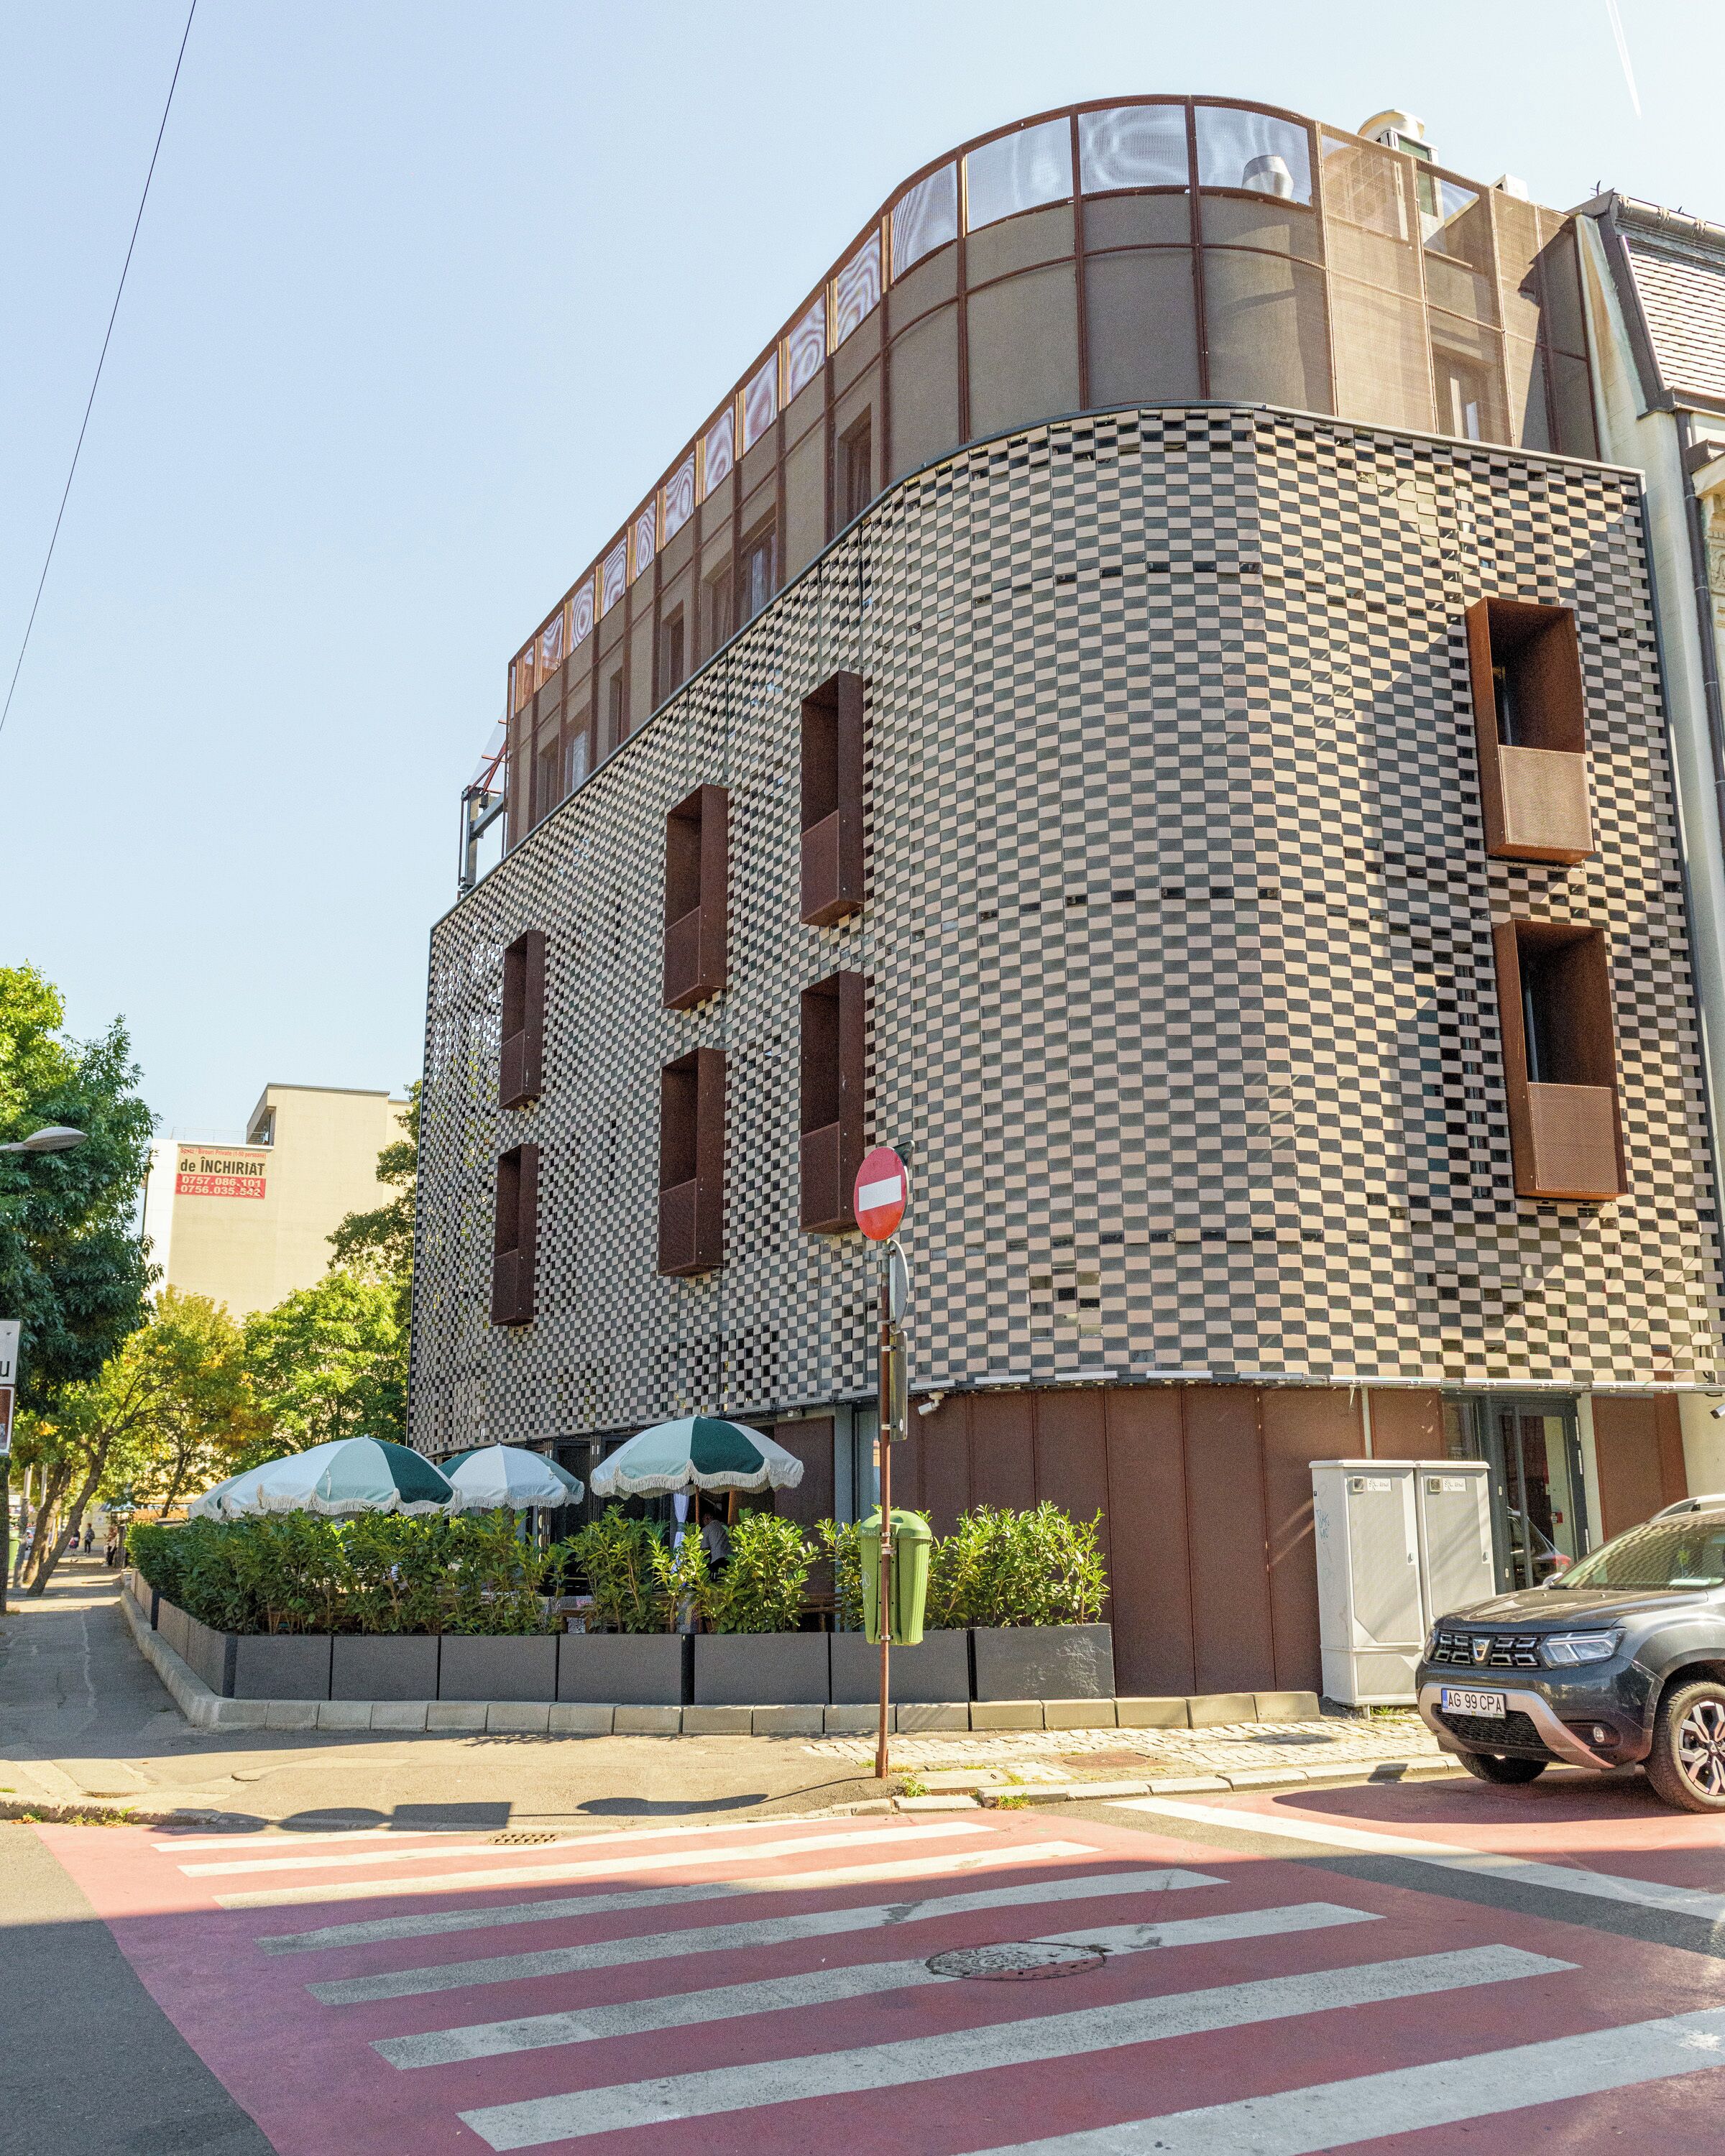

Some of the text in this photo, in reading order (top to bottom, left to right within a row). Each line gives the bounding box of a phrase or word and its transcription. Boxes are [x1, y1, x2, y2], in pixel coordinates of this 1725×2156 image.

[180, 1156, 264, 1176] de ÎNCHIRIAT
[182, 1176, 261, 1187] 0757.086.101
[180, 1184, 261, 1197] 0756.035.542
[1448, 1692, 1461, 1707] AG
[1465, 1693, 1477, 1709] 99
[1480, 1695, 1502, 1712] CPA
